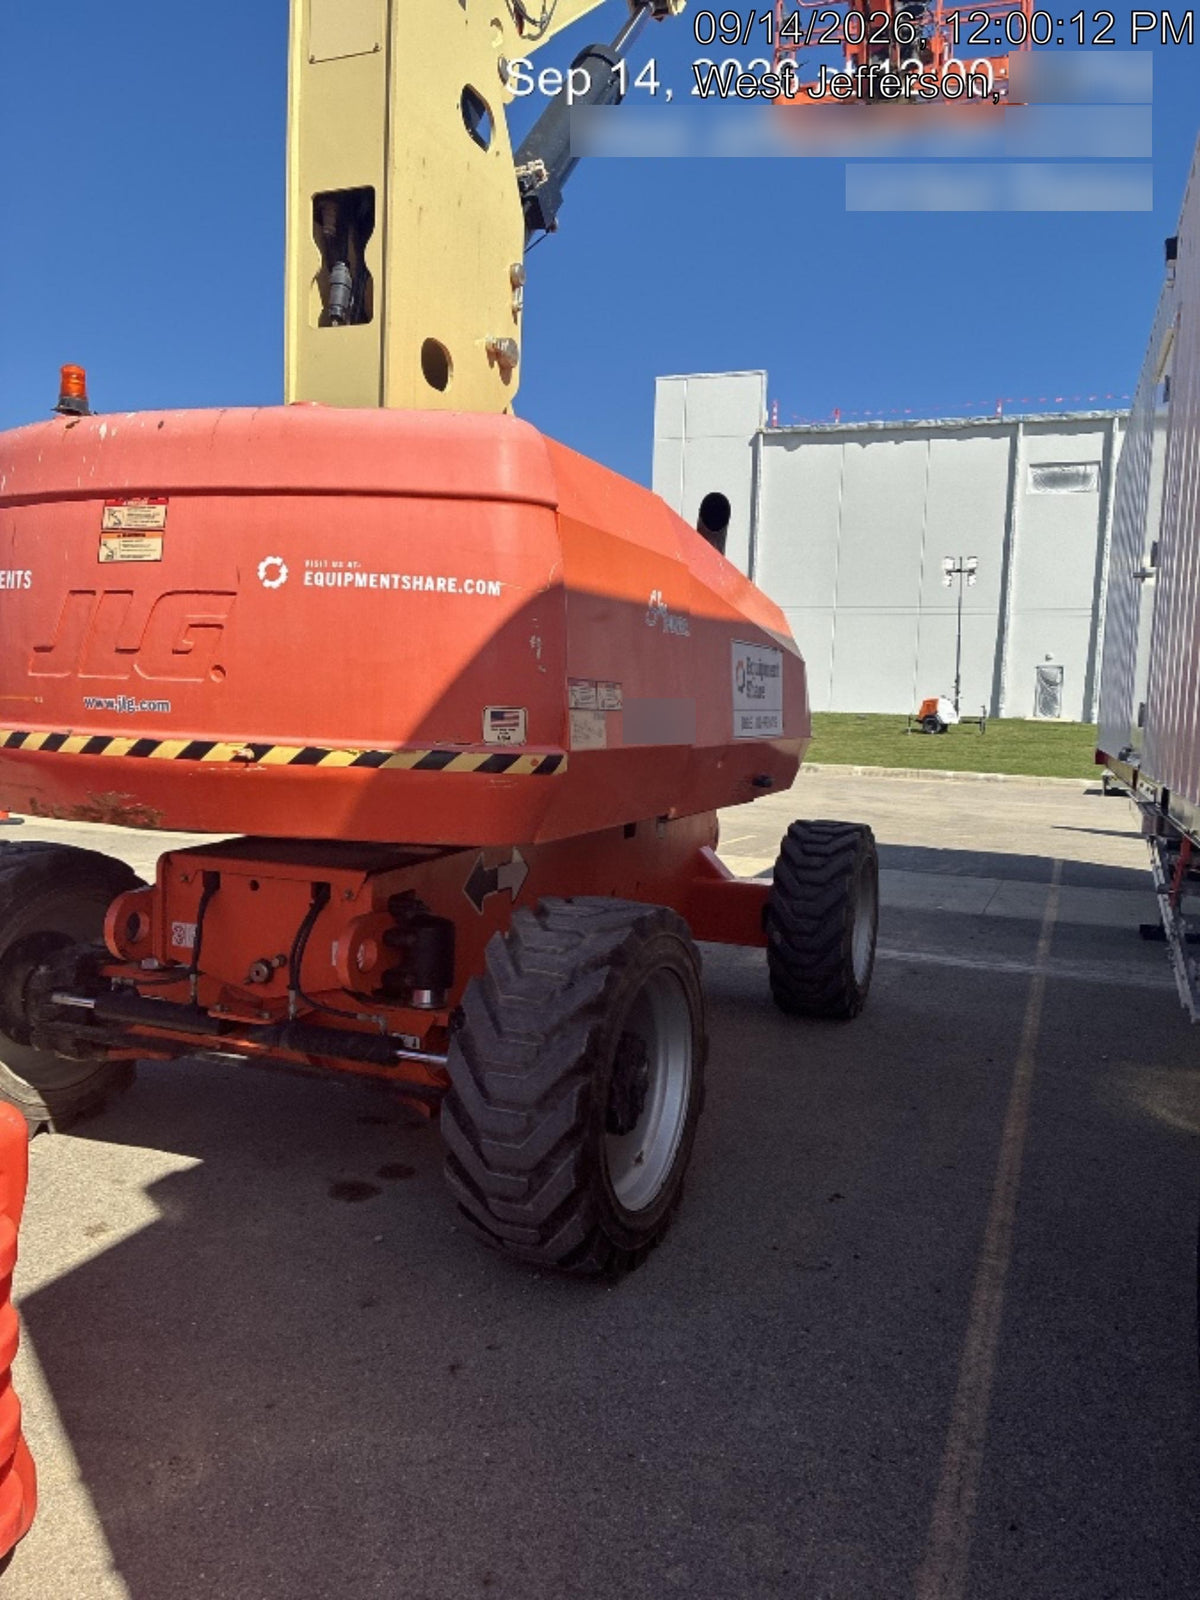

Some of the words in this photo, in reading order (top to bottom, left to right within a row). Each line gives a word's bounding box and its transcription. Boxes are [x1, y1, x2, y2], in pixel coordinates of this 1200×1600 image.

[304, 571, 501, 596] EQUIPMENTSHARE.COM
[28, 589, 237, 682] JLG
[83, 695, 171, 713] www.jlg.com
